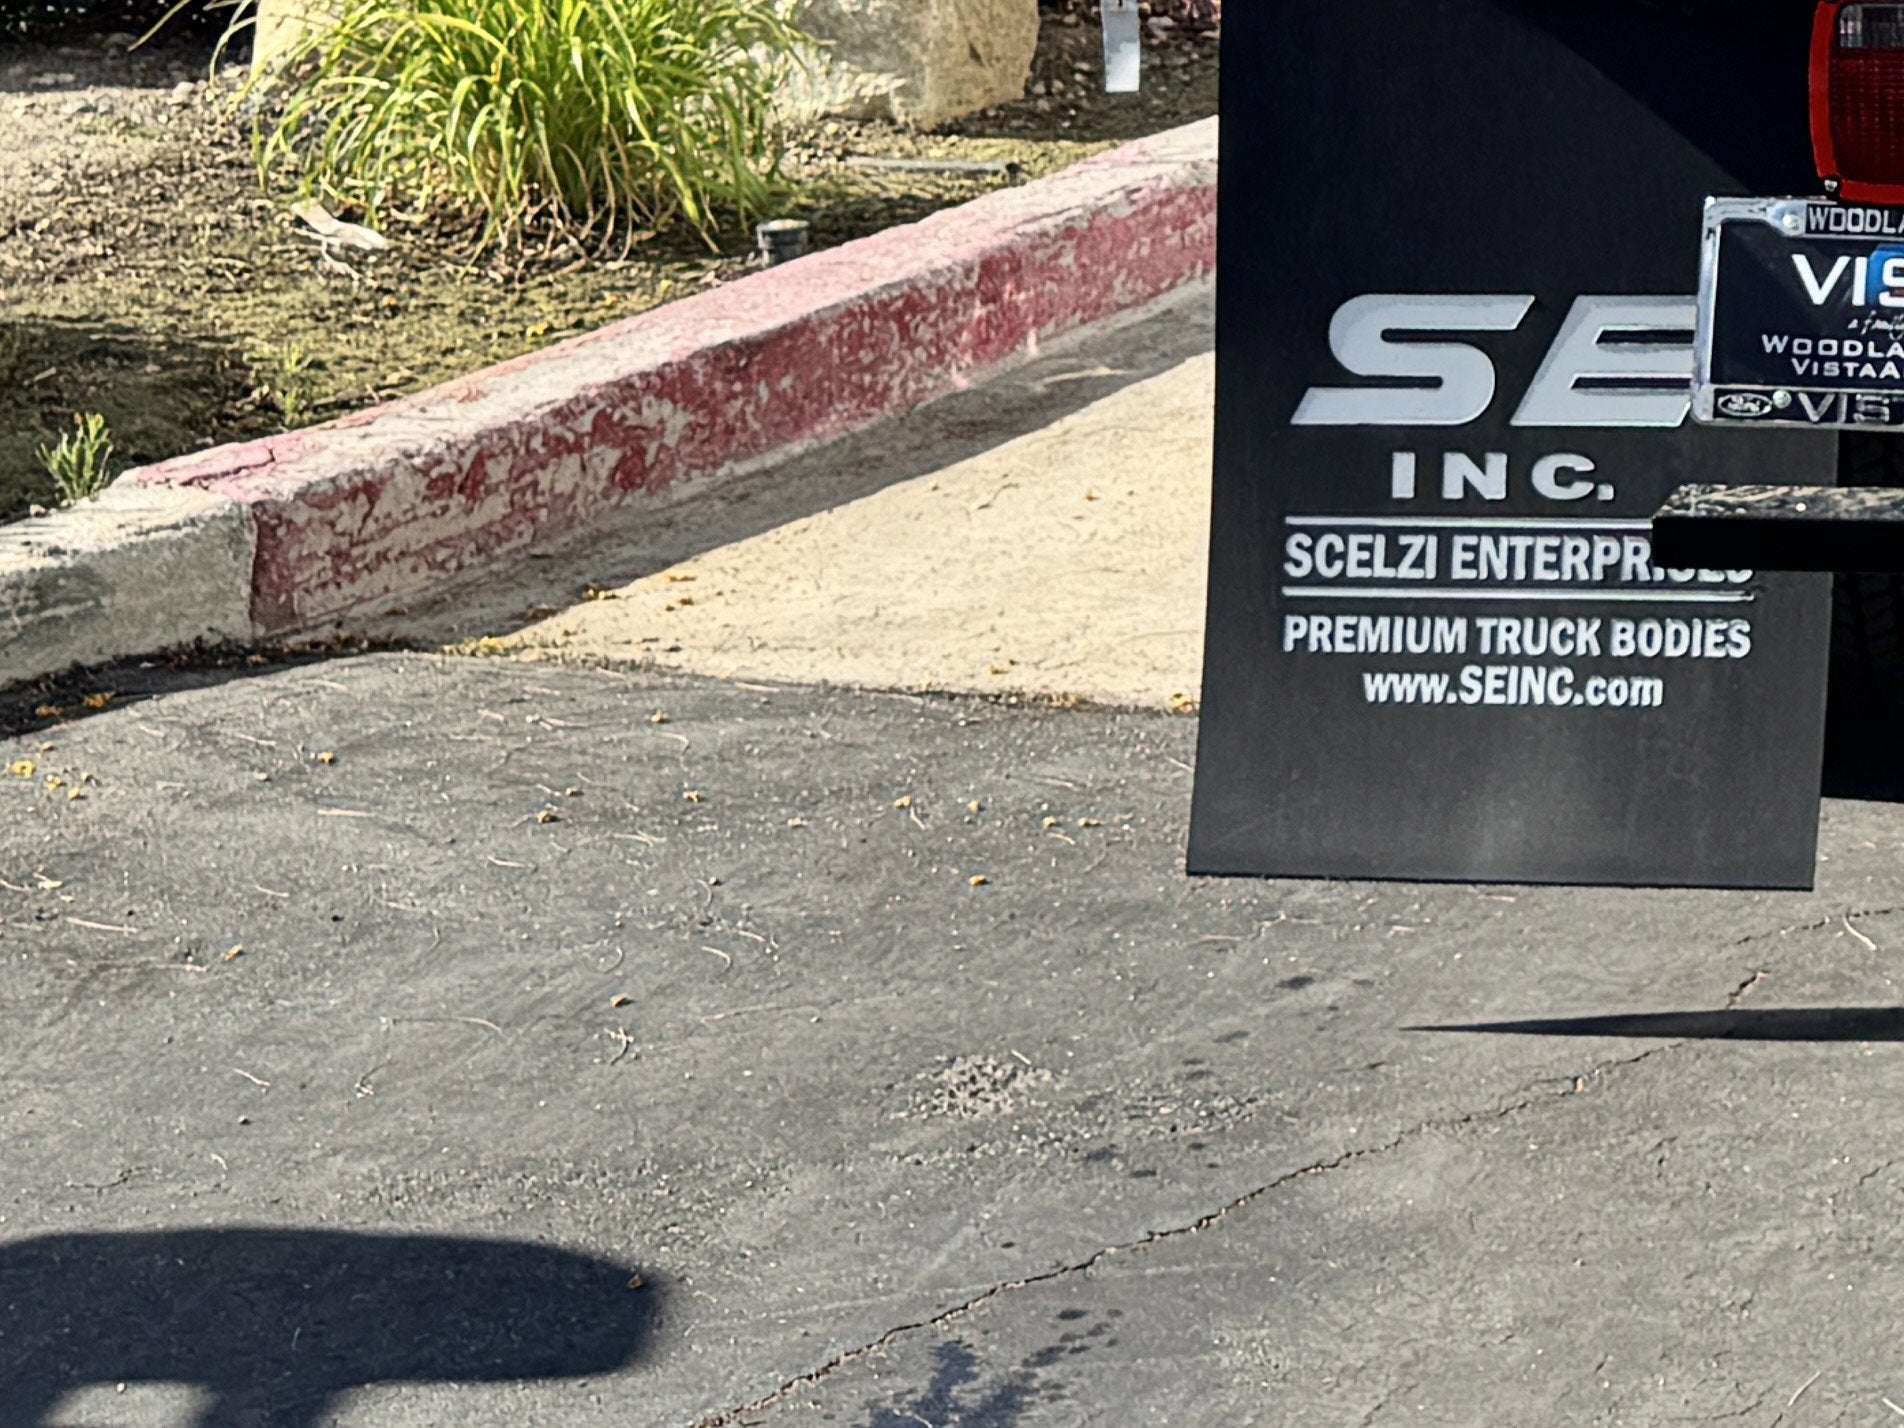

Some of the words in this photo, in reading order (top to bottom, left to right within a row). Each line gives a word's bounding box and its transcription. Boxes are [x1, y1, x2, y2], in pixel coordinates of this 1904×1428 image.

[1289, 293, 1698, 428] SE
[1390, 451, 1615, 501] INC.
[1283, 532, 1438, 581] SCELZI
[1451, 533, 1756, 584] ENTERPR
[1283, 614, 1468, 655] PREMIUM
[1475, 616, 1602, 657] TRUCK
[1610, 617, 1752, 659] BODIES
[1362, 664, 1664, 707] www.SEINC.com
